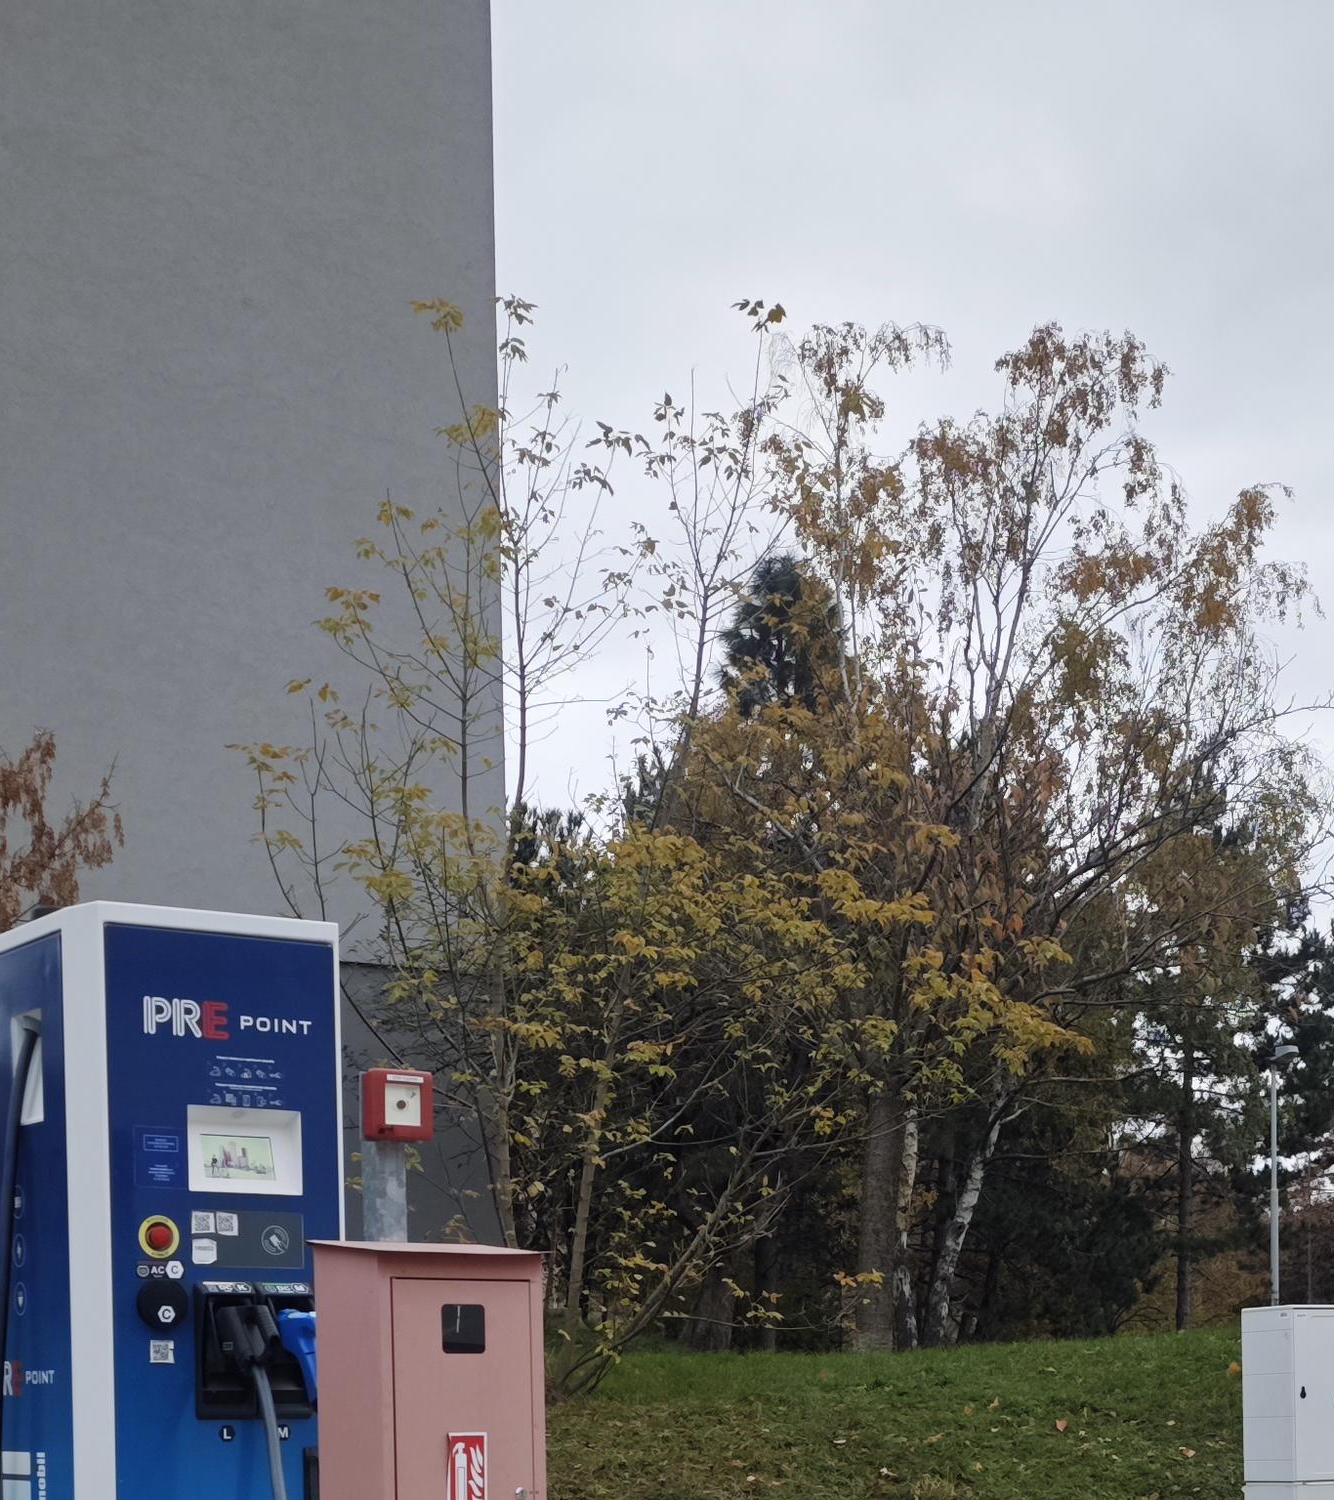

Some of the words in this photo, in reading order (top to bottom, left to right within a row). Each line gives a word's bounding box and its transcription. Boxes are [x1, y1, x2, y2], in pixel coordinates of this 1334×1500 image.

[143, 995, 230, 1041] PRE
[240, 1015, 312, 1035] POINT
[150, 1266, 165, 1275] AC
[162, 1308, 172, 1321] C
[3, 1360, 23, 1397] RE
[25, 1369, 55, 1385] POINT
[223, 1428, 232, 1440] L
[277, 1427, 289, 1438] M
